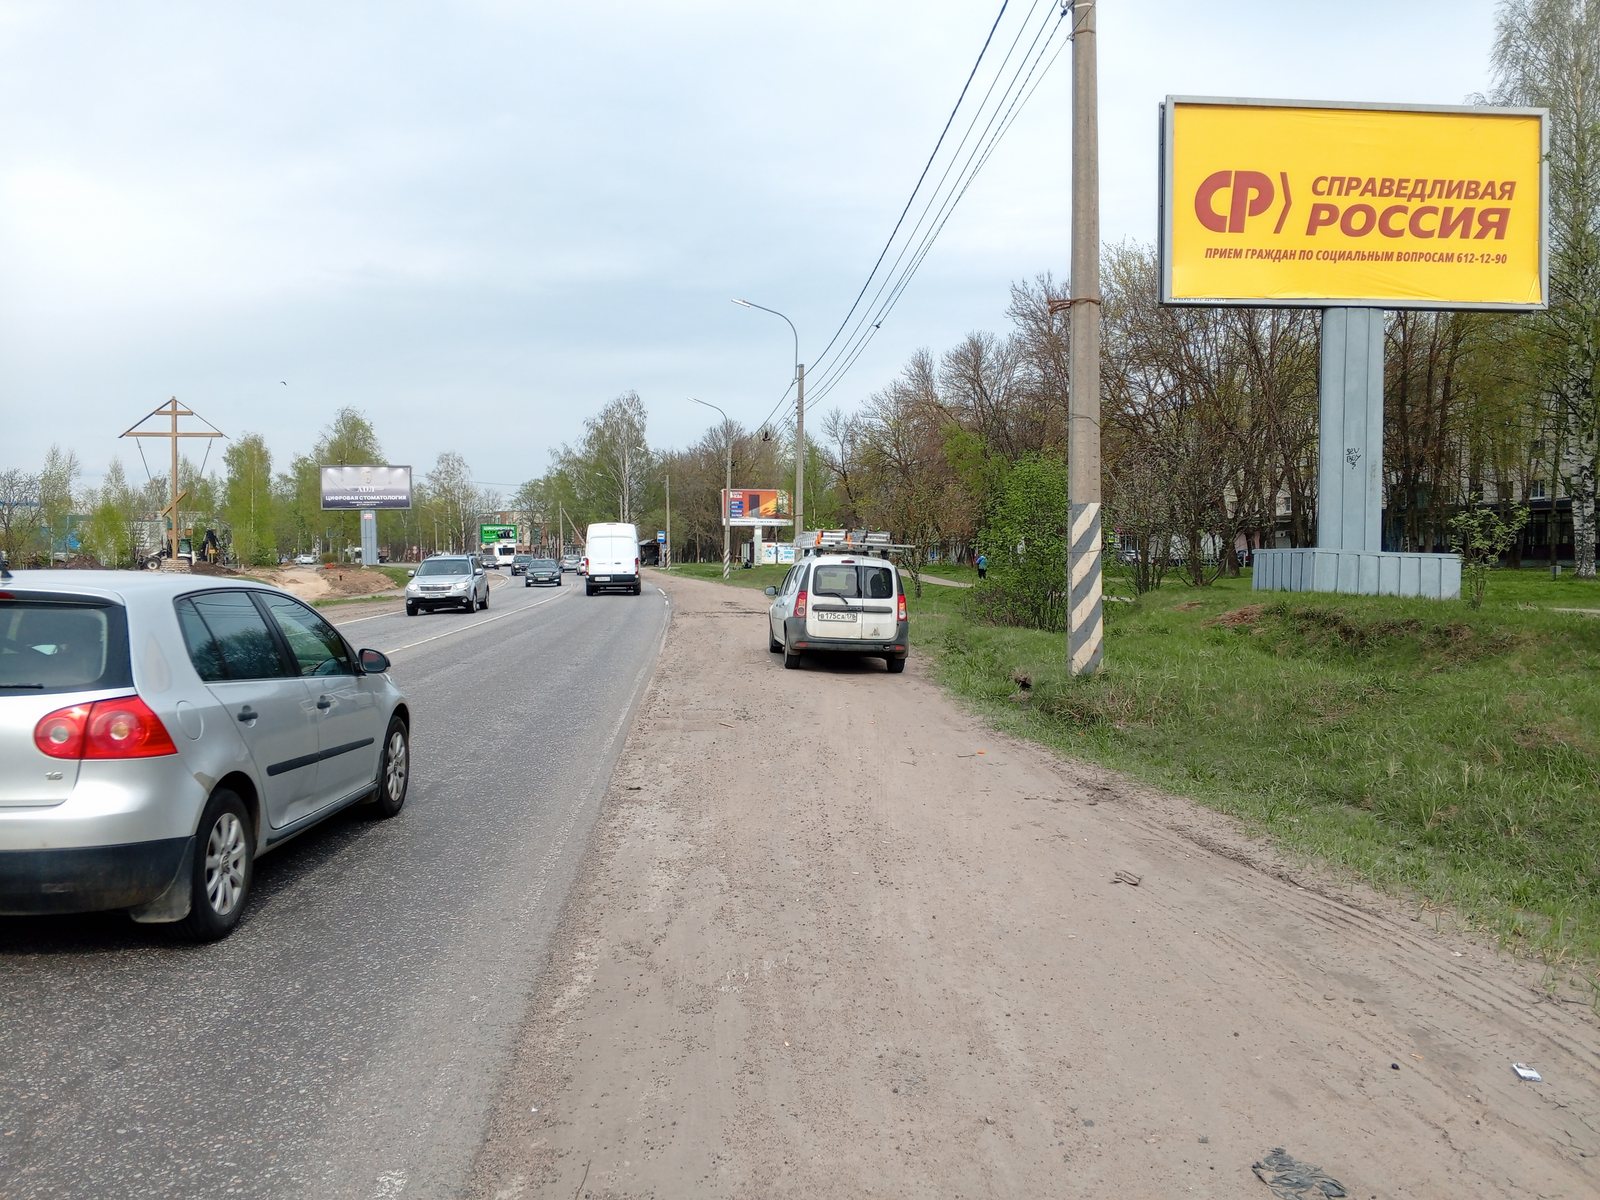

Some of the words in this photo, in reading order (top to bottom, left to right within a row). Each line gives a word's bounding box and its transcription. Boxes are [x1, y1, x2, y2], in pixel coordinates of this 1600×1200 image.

[1194, 170, 1275, 234] СР
[1311, 175, 1516, 203] СПРАВЕДЛИВАЯ
[1305, 203, 1511, 240] РОССИЯ
[1205, 247, 1242, 259] ПРИЕМ
[1244, 248, 1297, 262] ГРАЖДАН
[1298, 249, 1313, 261] ПО
[1315, 249, 1394, 263] СОЦИАЛЬНЫМ
[1395, 251, 1455, 263] ВОПРОСАМ
[1456, 252, 1507, 264] 612-12-90
